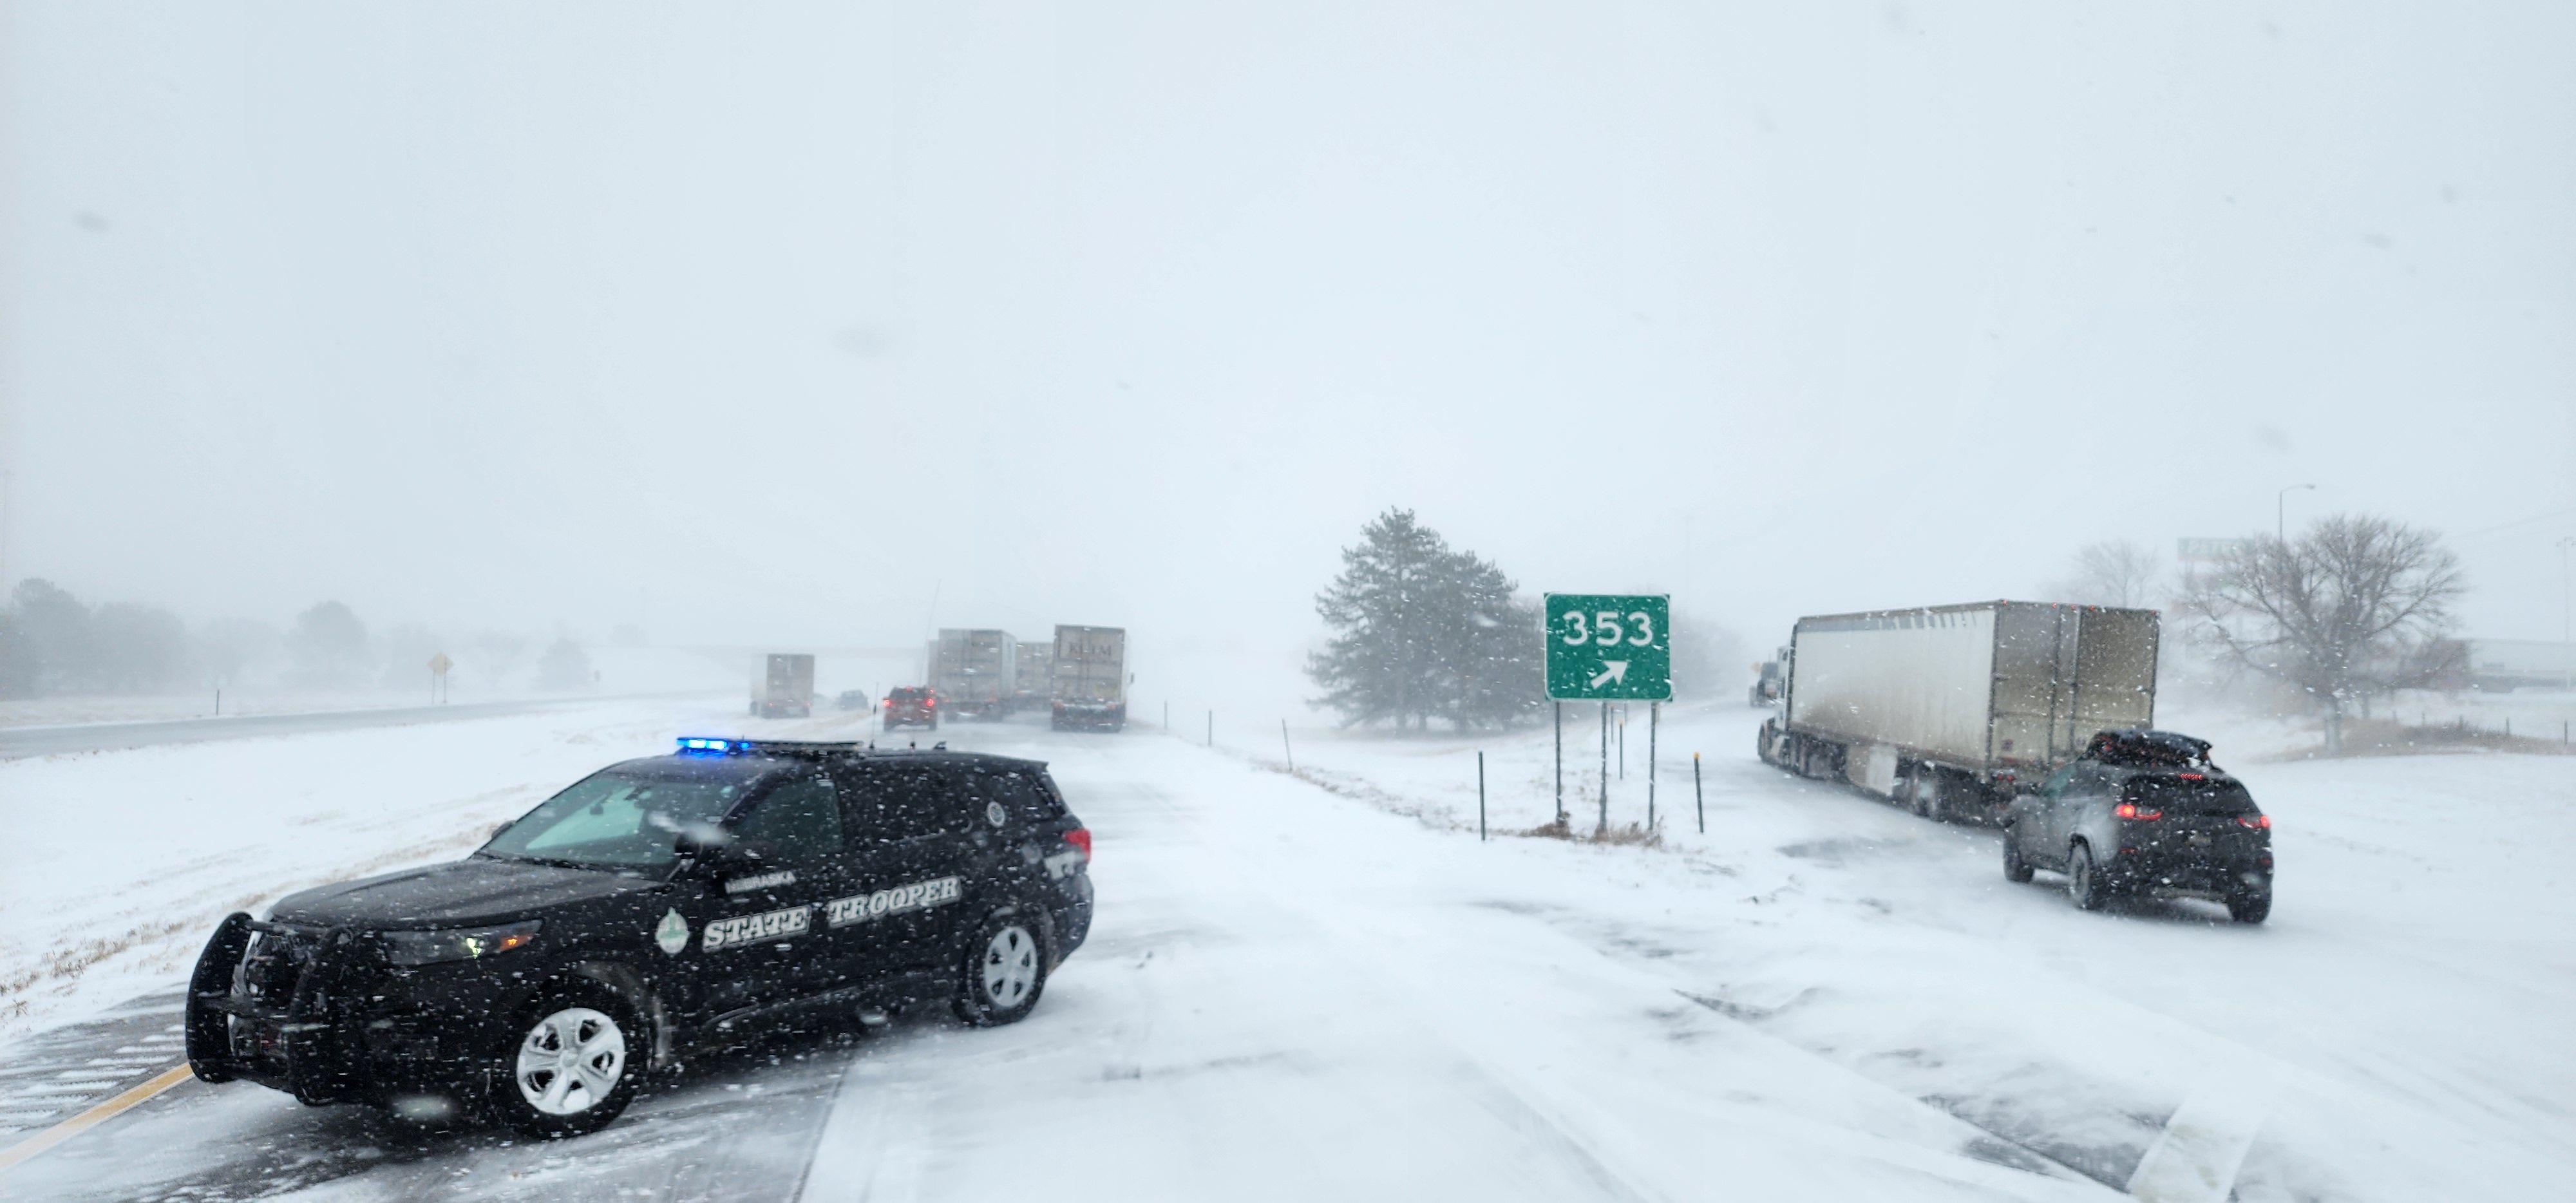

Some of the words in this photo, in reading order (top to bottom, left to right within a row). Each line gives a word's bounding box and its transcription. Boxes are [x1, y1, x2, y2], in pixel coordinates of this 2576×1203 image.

[1562, 610, 1653, 647] 353
[703, 905, 810, 949] STATE
[828, 876, 960, 925] TROOPER
